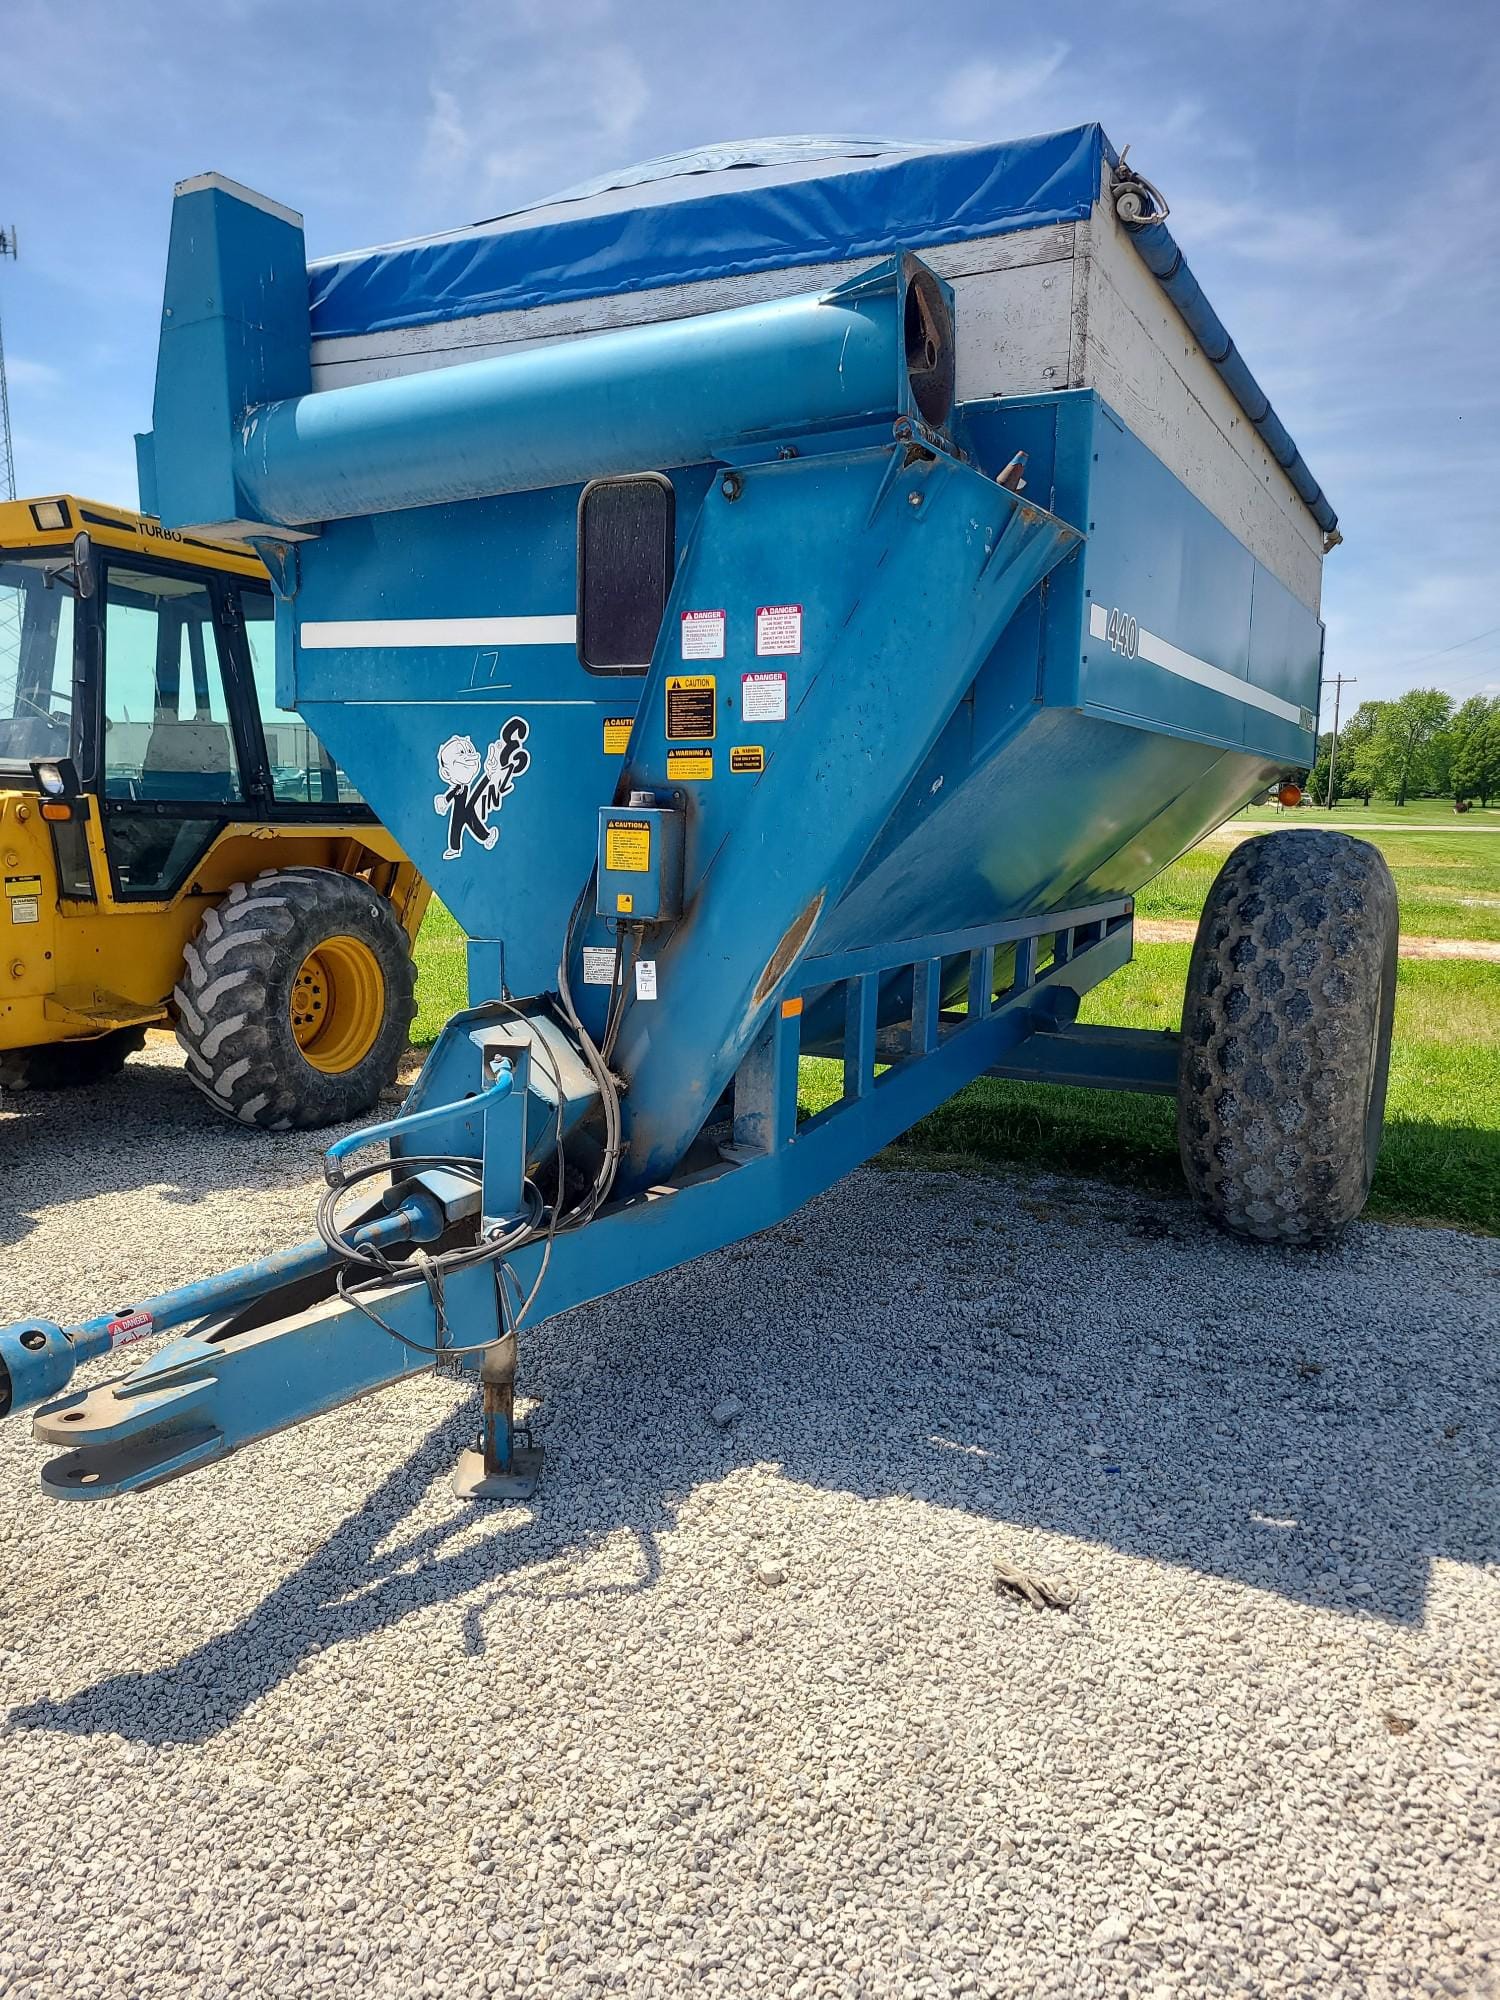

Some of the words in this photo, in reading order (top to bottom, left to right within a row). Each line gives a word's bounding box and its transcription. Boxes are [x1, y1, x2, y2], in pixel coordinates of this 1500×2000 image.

[136, 521, 182, 542] TURBO
[769, 606, 798, 615] DANGER
[693, 611, 721, 620] DANGER
[1107, 607, 1137, 660] 440
[470, 651, 499, 687] 17
[754, 673, 783, 681] DANGER
[685, 679, 710, 688] CAUTION
[675, 749, 704, 757] WARNING
[615, 821, 643, 829] CAUTION
[122, 1314, 149, 1329] DANGER
